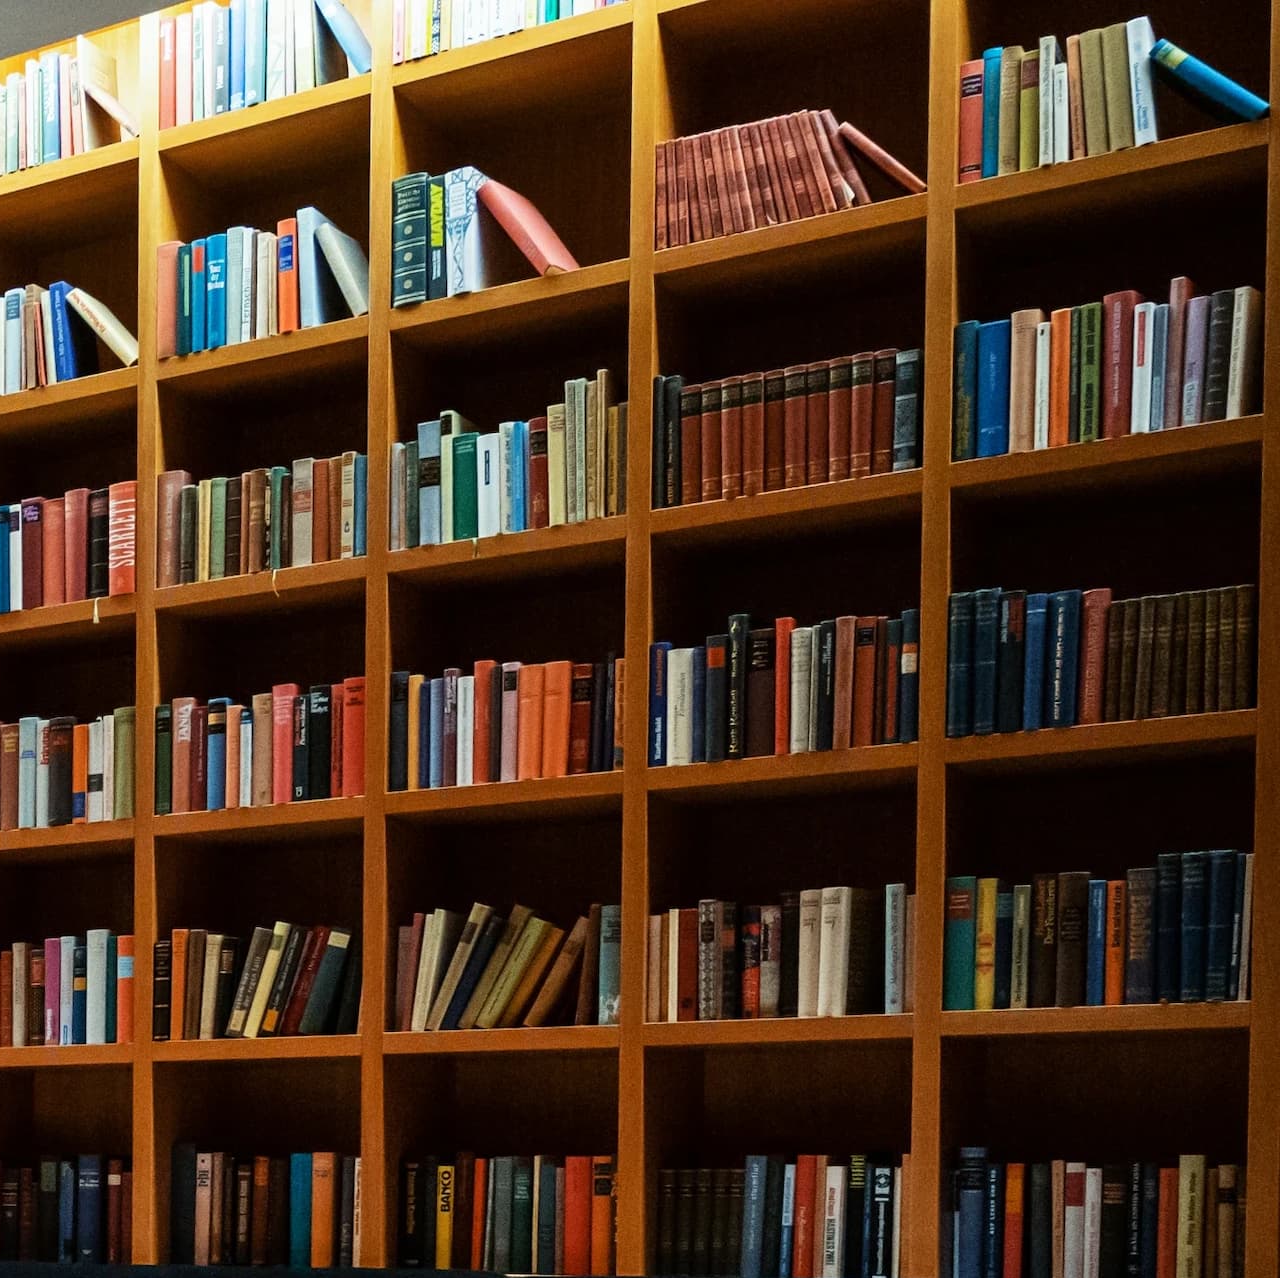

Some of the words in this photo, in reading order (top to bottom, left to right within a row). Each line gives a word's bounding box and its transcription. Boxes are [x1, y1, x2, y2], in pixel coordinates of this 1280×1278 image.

[109, 498, 135, 569] SCARLETT
[1044, 927, 1053, 945] Der
[441, 1171, 451, 1212] BANCO
